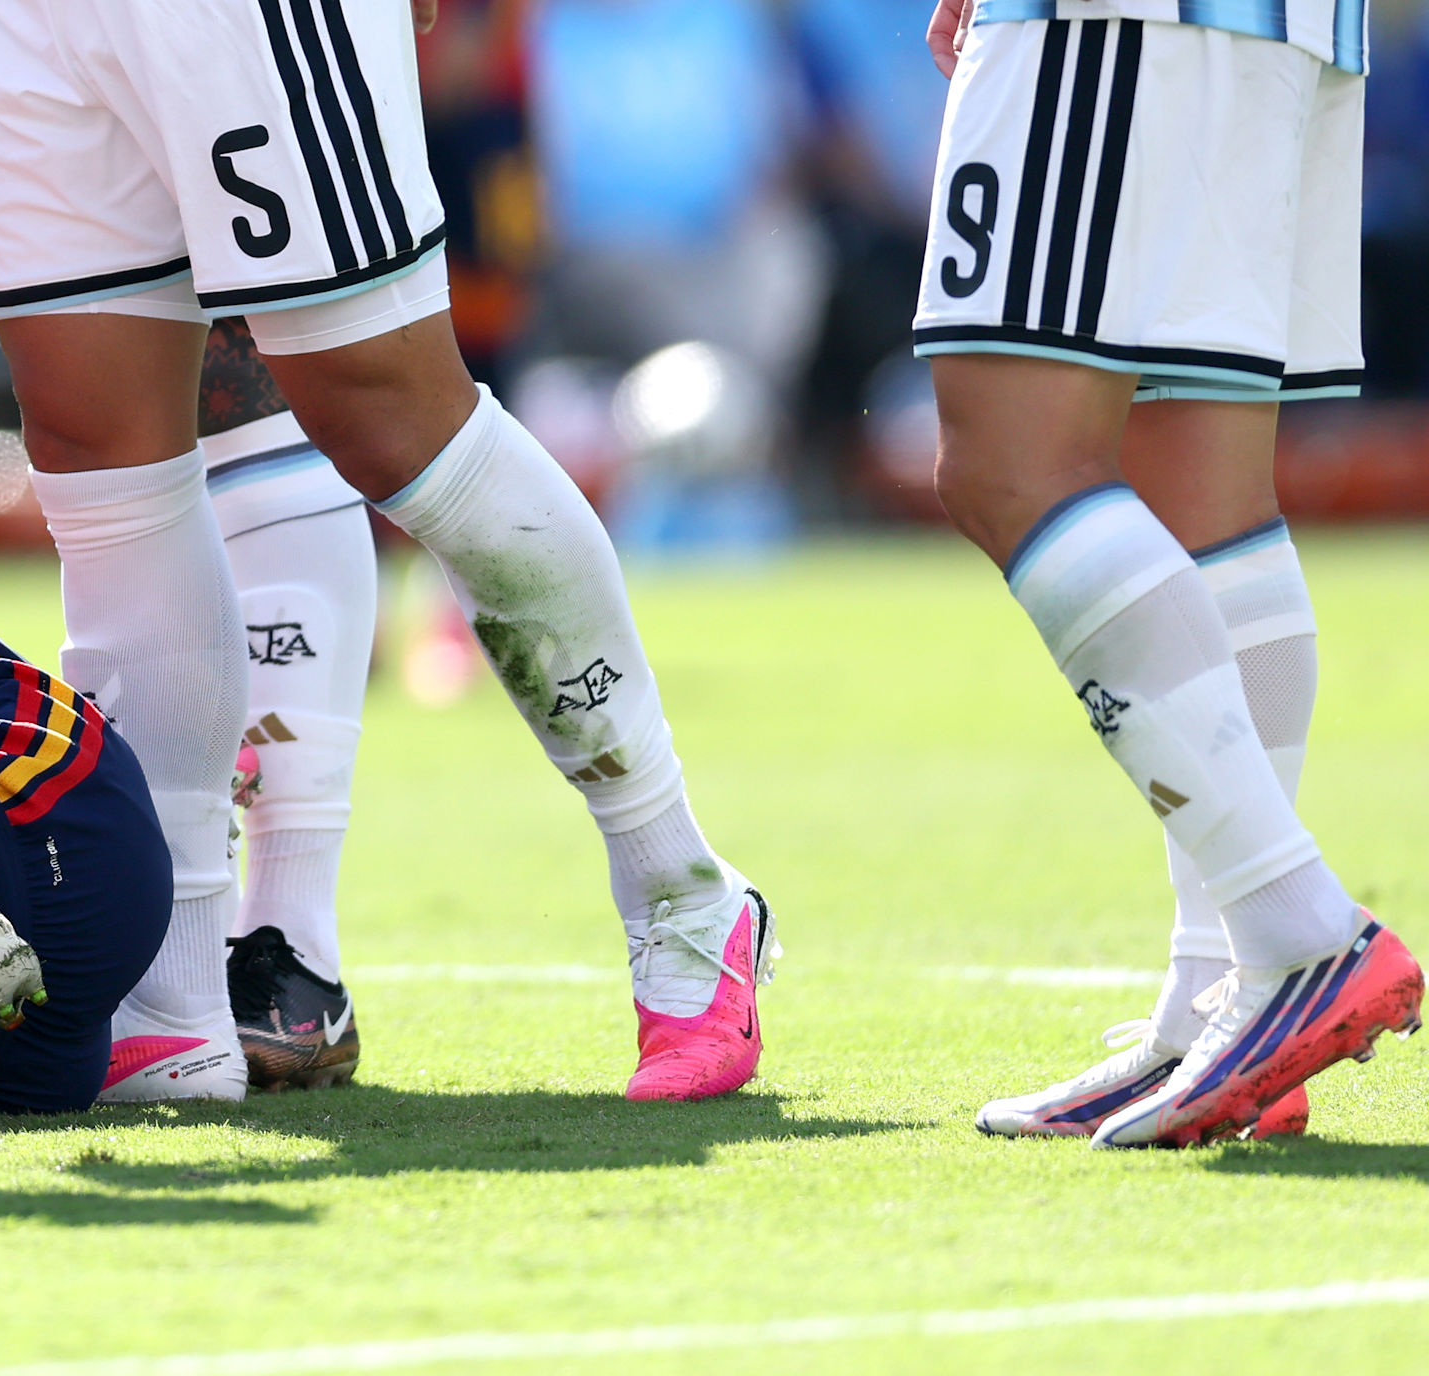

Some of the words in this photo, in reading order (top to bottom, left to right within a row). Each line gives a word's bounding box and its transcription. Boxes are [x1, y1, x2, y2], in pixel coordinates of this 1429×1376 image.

[211, 124, 291, 259] 5
[940, 161, 1000, 299] 9
[548, 657, 623, 718] AFA
